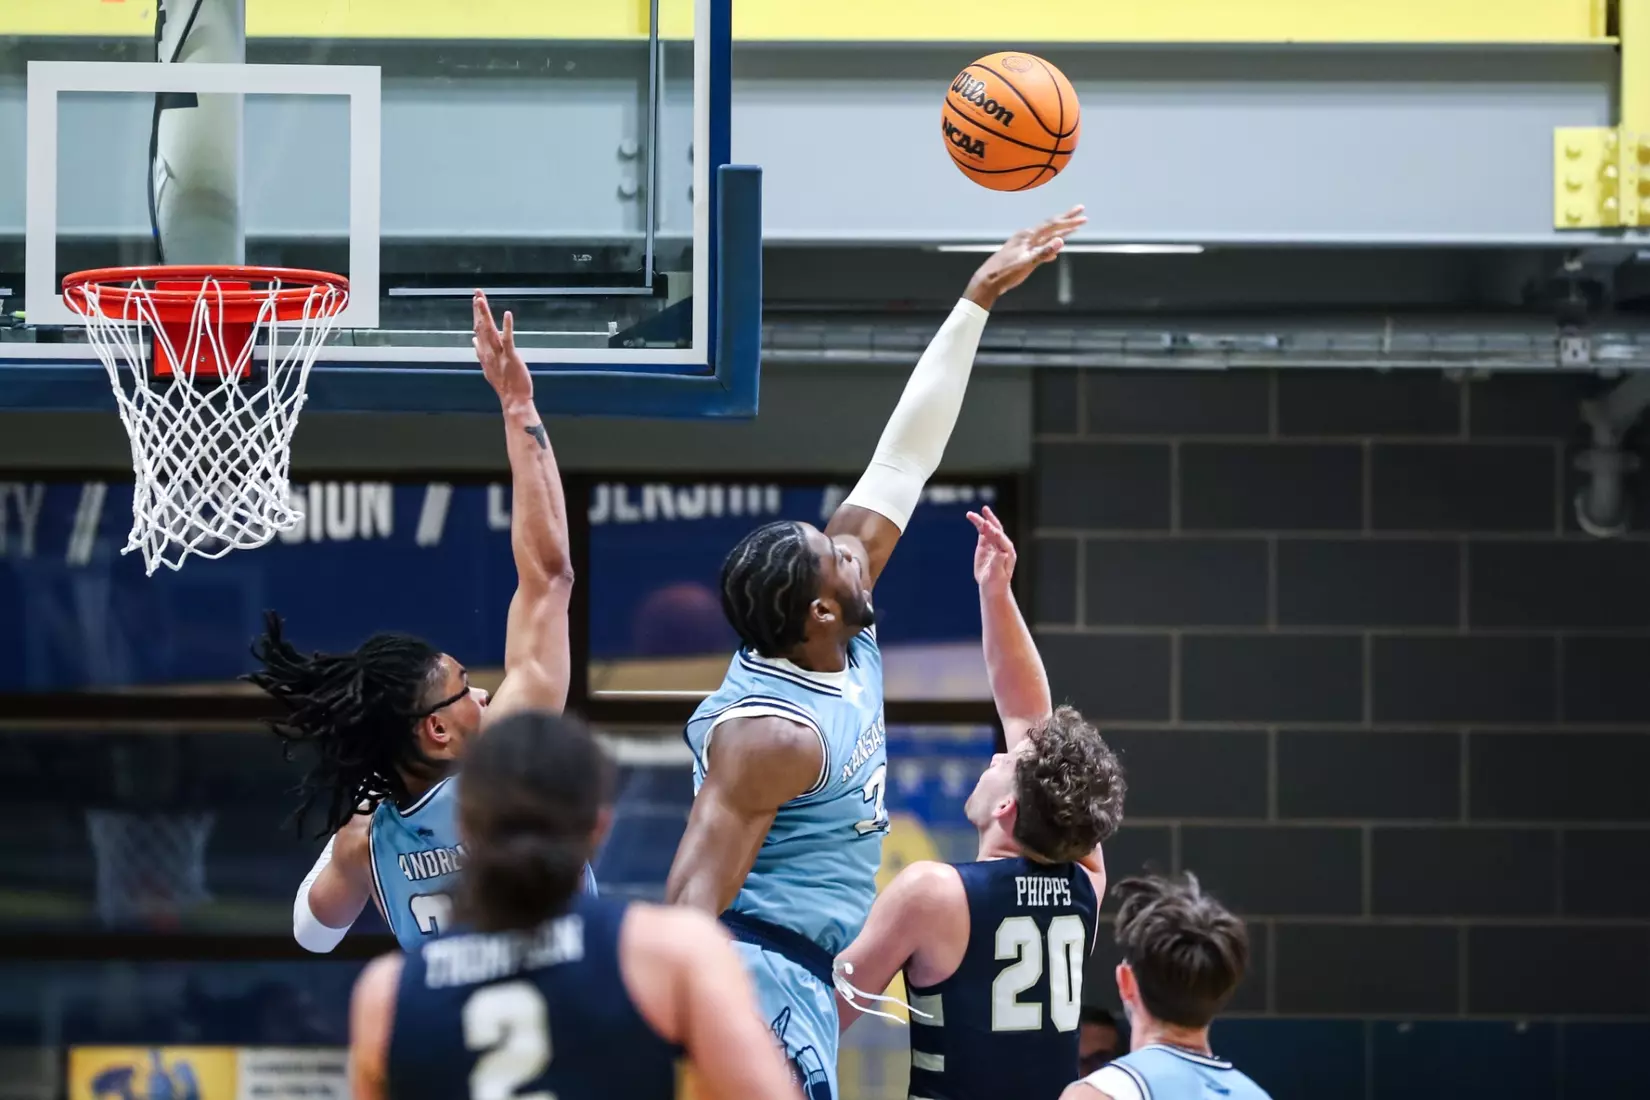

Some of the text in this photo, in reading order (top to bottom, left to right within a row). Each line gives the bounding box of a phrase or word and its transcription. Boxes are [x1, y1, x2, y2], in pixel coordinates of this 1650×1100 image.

[951, 70, 1015, 127] Wilson
[942, 116, 986, 159] NCAA
[1015, 876, 1072, 906] PHIPPS
[991, 914, 1086, 1033] 20
[461, 981, 557, 1100] 2
